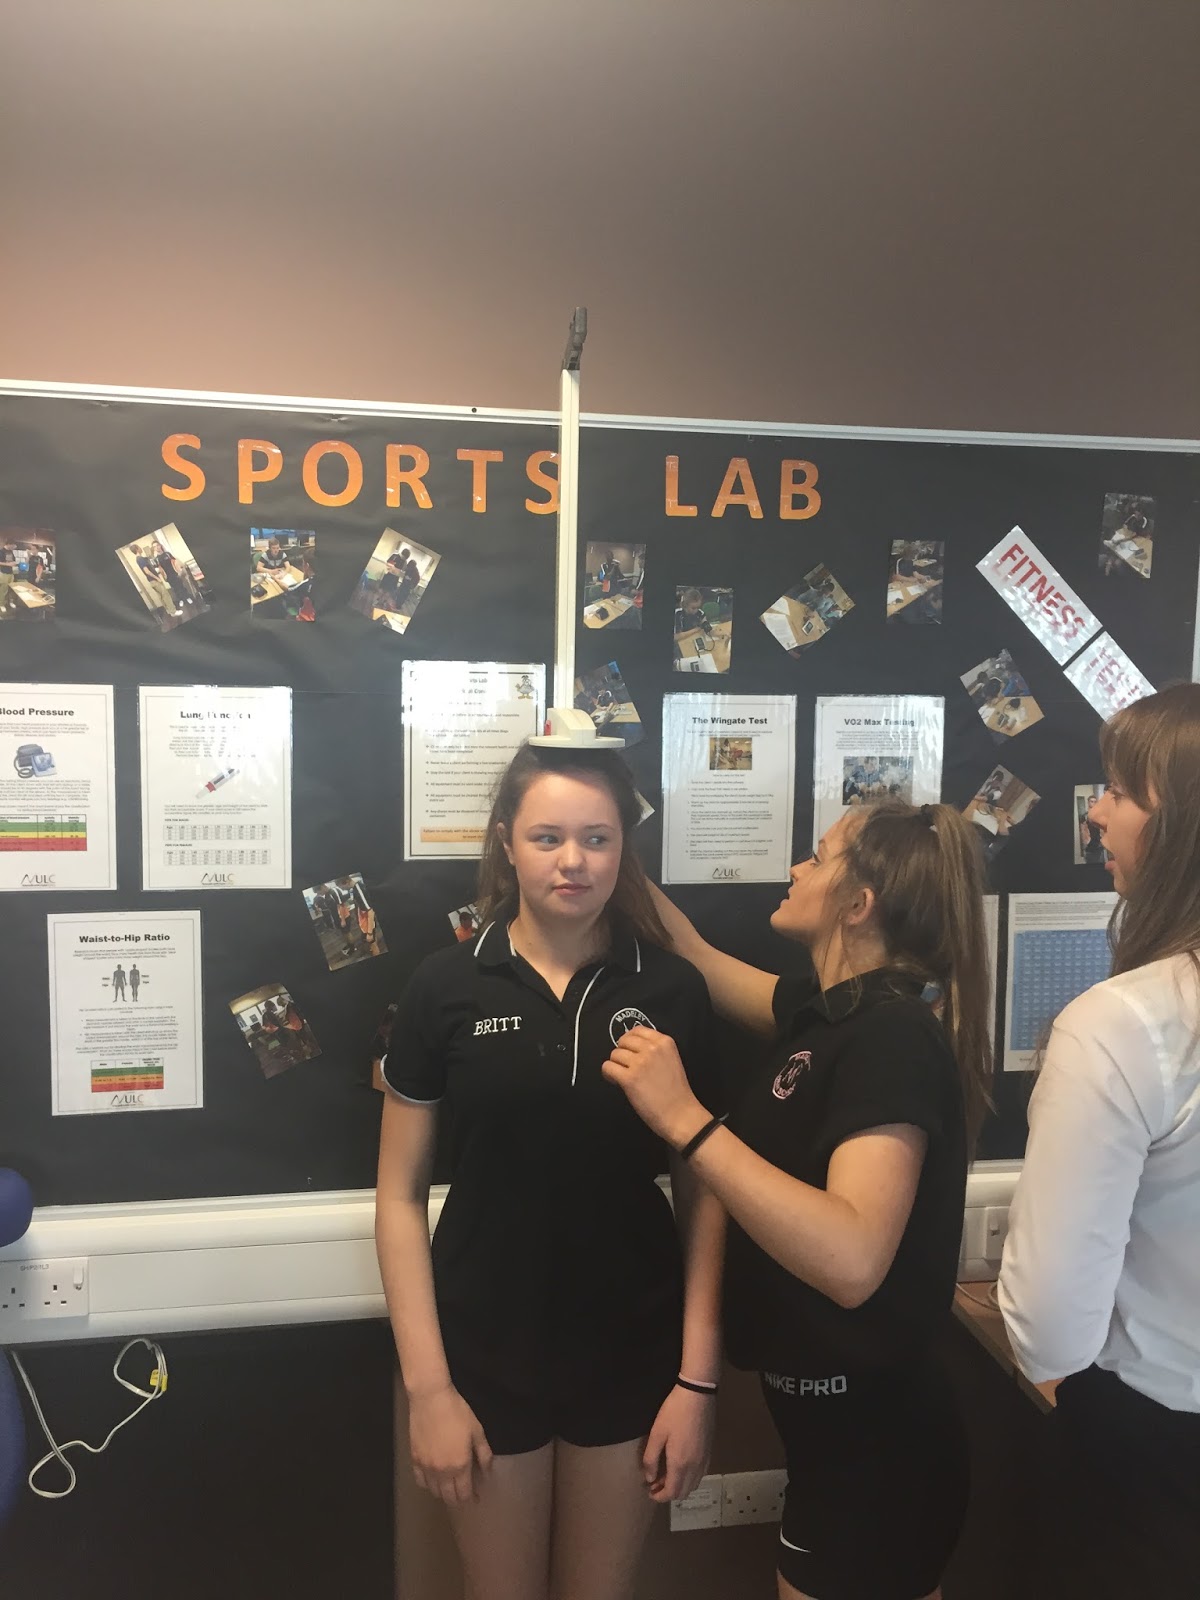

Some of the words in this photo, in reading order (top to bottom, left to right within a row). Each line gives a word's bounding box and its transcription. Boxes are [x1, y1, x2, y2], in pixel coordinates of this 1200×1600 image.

[161, 433, 560, 516] SPORTS
[664, 455, 822, 520] LAB
[28, 708, 75, 716] Pressure
[711, 717, 746, 725] Wingate
[844, 718, 862, 726] VO2
[864, 718, 882, 726] Max
[79, 934, 141, 943] Waist-to-Hip
[473, 1015, 522, 1036] BRITT
[764, 1371, 795, 1395] NIKE
[799, 1375, 848, 1397] PRO
